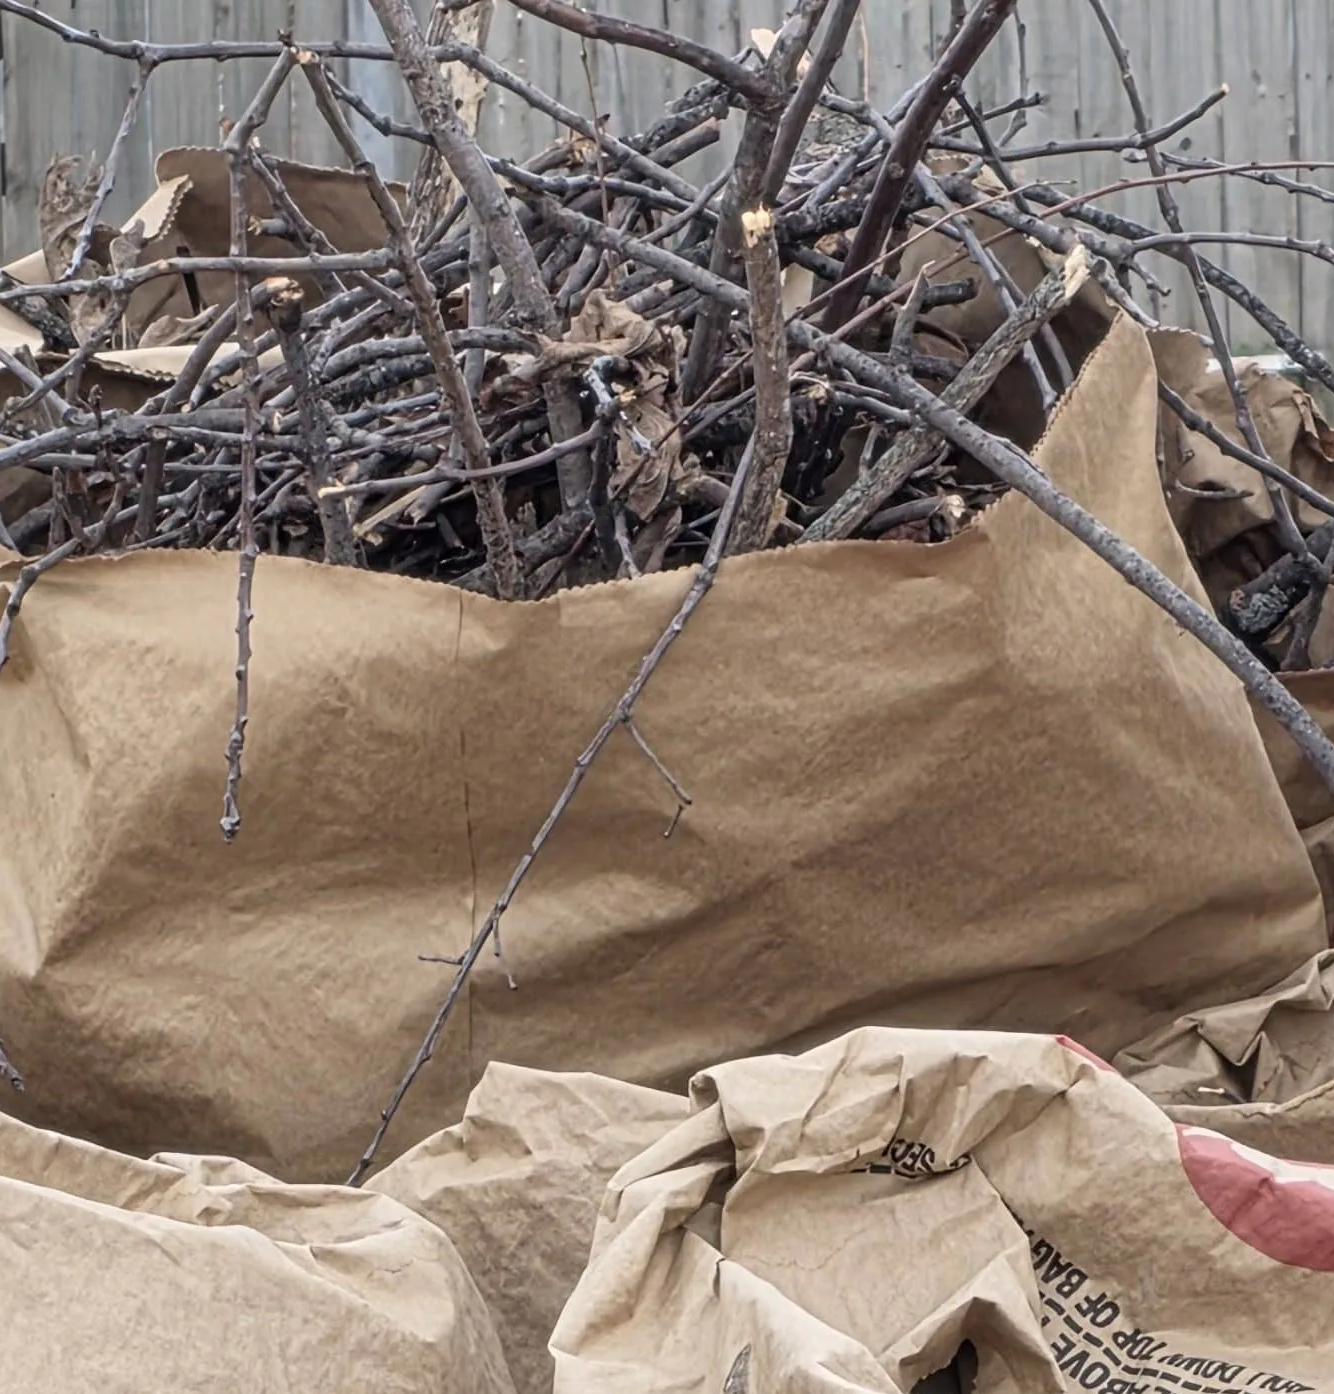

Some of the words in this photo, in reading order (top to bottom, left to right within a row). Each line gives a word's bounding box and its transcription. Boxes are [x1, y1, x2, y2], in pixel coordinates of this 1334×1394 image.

[1030, 1238, 1089, 1300] BAG
[1074, 1291, 1121, 1329] OF
[1111, 1327, 1168, 1362] TOP
